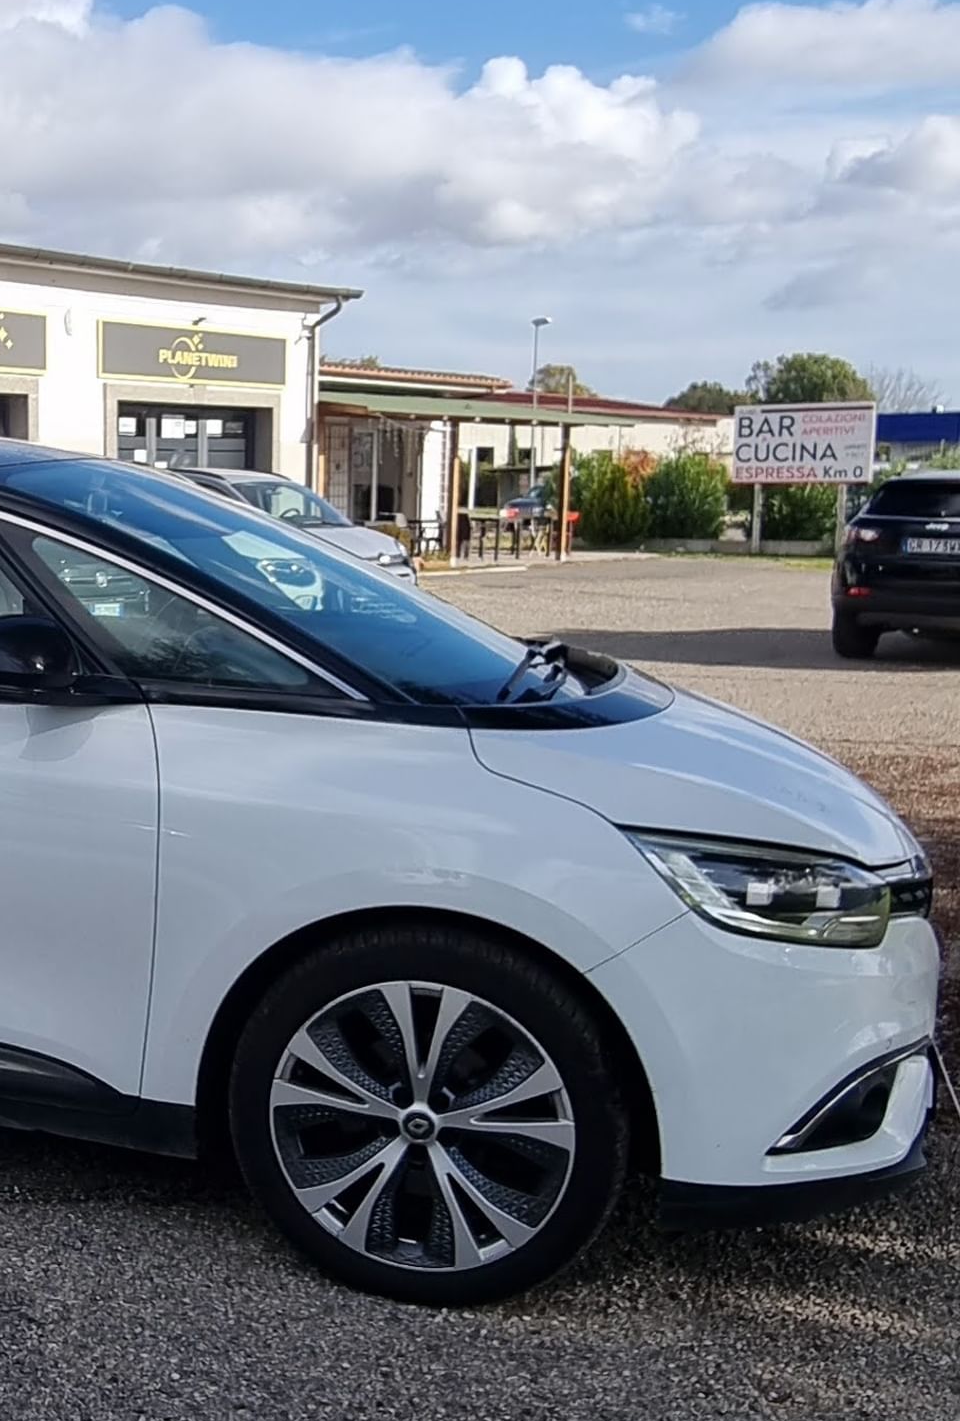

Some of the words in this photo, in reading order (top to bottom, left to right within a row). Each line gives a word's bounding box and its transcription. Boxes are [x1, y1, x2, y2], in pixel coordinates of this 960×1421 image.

[801, 413, 865, 425] COLAZIONI
[738, 415, 795, 438] BAR
[800, 425, 856, 437] APERITIVI
[735, 442, 838, 463] CUCINA
[735, 465, 818, 479] ESPRESSA
[823, 465, 847, 479] Km
[853, 465, 863, 479] 0
